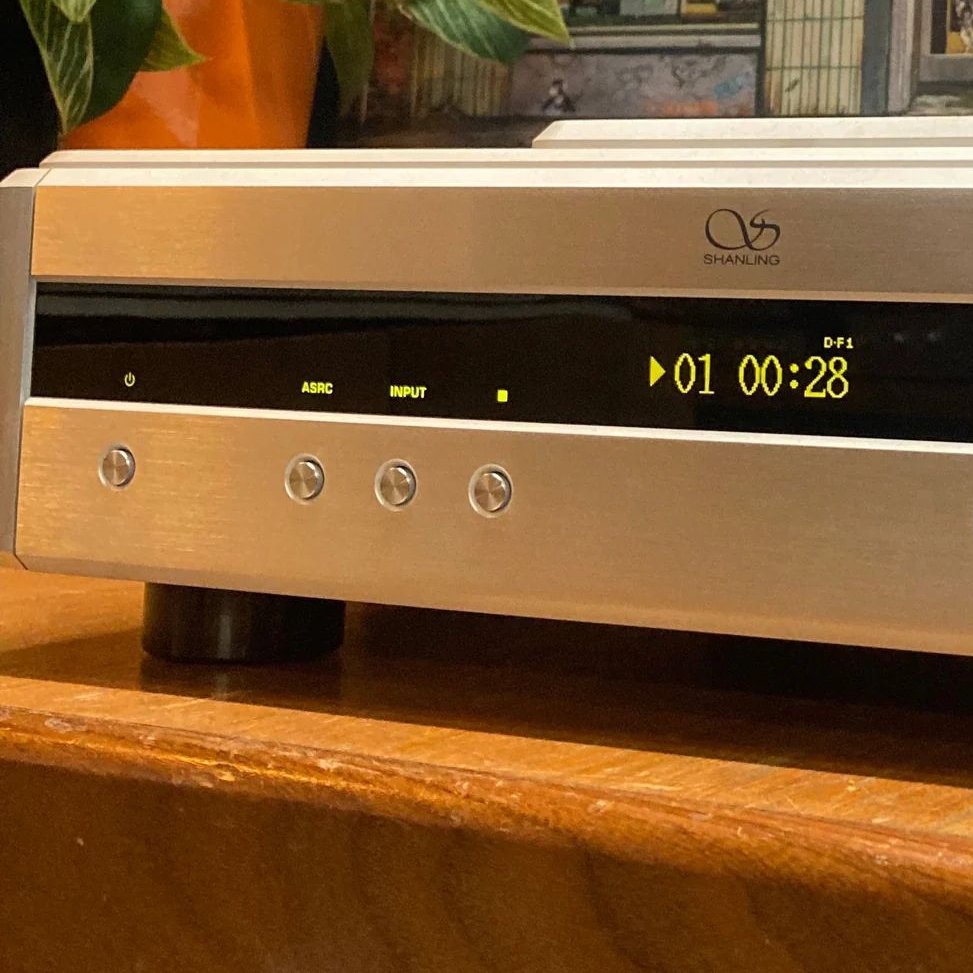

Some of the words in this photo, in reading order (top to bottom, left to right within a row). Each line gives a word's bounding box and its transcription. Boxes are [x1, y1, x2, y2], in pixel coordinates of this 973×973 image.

[703, 253, 782, 267] SHANLING
[674, 353, 715, 395] 01
[738, 355, 850, 399] 00:28
[301, 381, 334, 395] ASRC
[389, 385, 428, 399] INPUT
